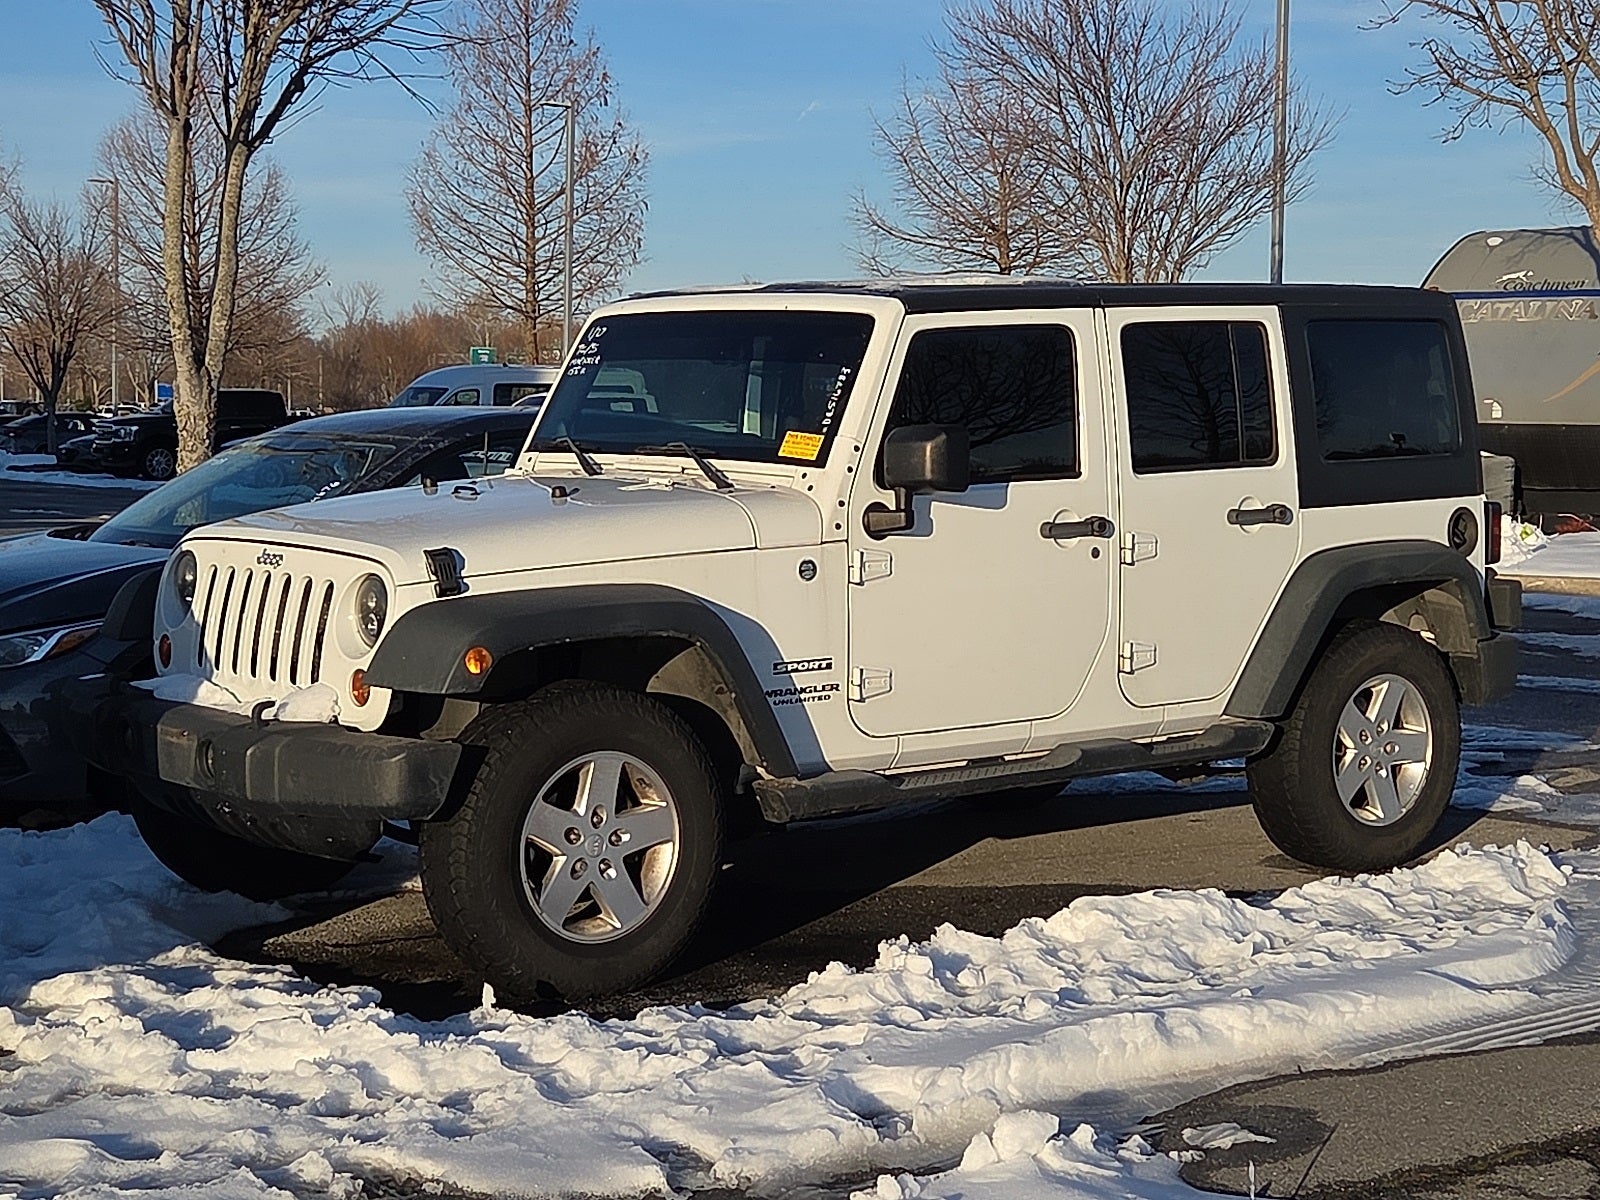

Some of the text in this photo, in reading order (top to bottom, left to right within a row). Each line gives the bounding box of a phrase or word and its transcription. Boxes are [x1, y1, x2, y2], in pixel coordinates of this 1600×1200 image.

[1503, 278, 1587, 291] Coachmen
[774, 659, 831, 673] SPORT
[764, 683, 841, 698] WRANGLER
[772, 694, 832, 706] UNLIMITED
